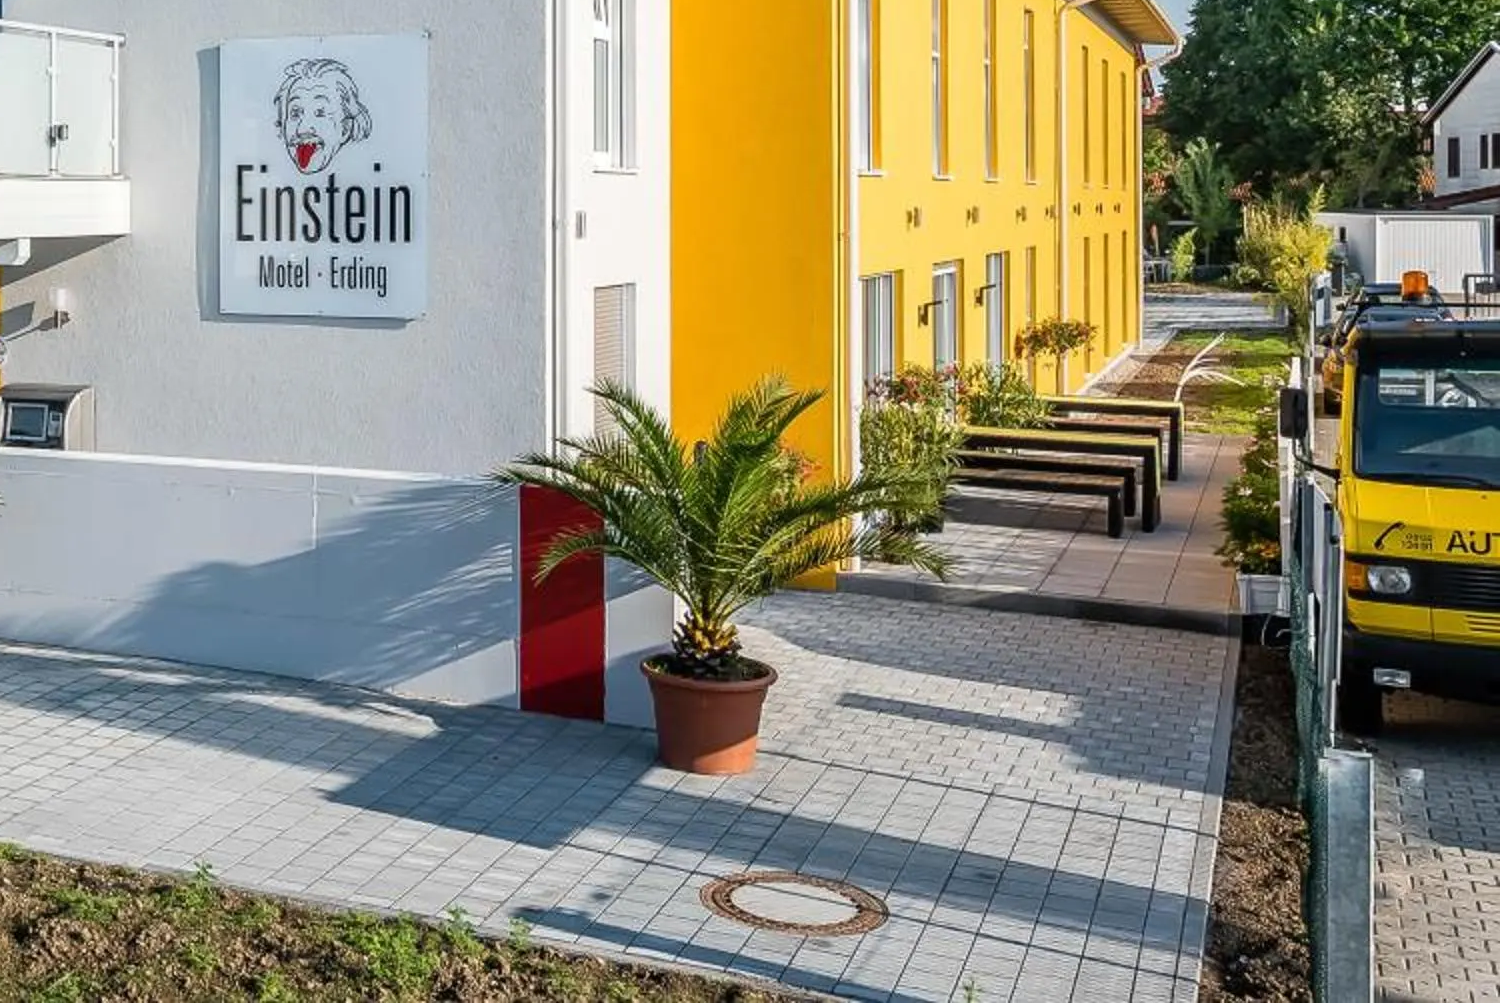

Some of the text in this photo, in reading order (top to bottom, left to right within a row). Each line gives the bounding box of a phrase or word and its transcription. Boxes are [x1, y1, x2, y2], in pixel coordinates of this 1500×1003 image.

[236, 163, 411, 243] Einstein
[259, 255, 388, 298] Motel Erding
